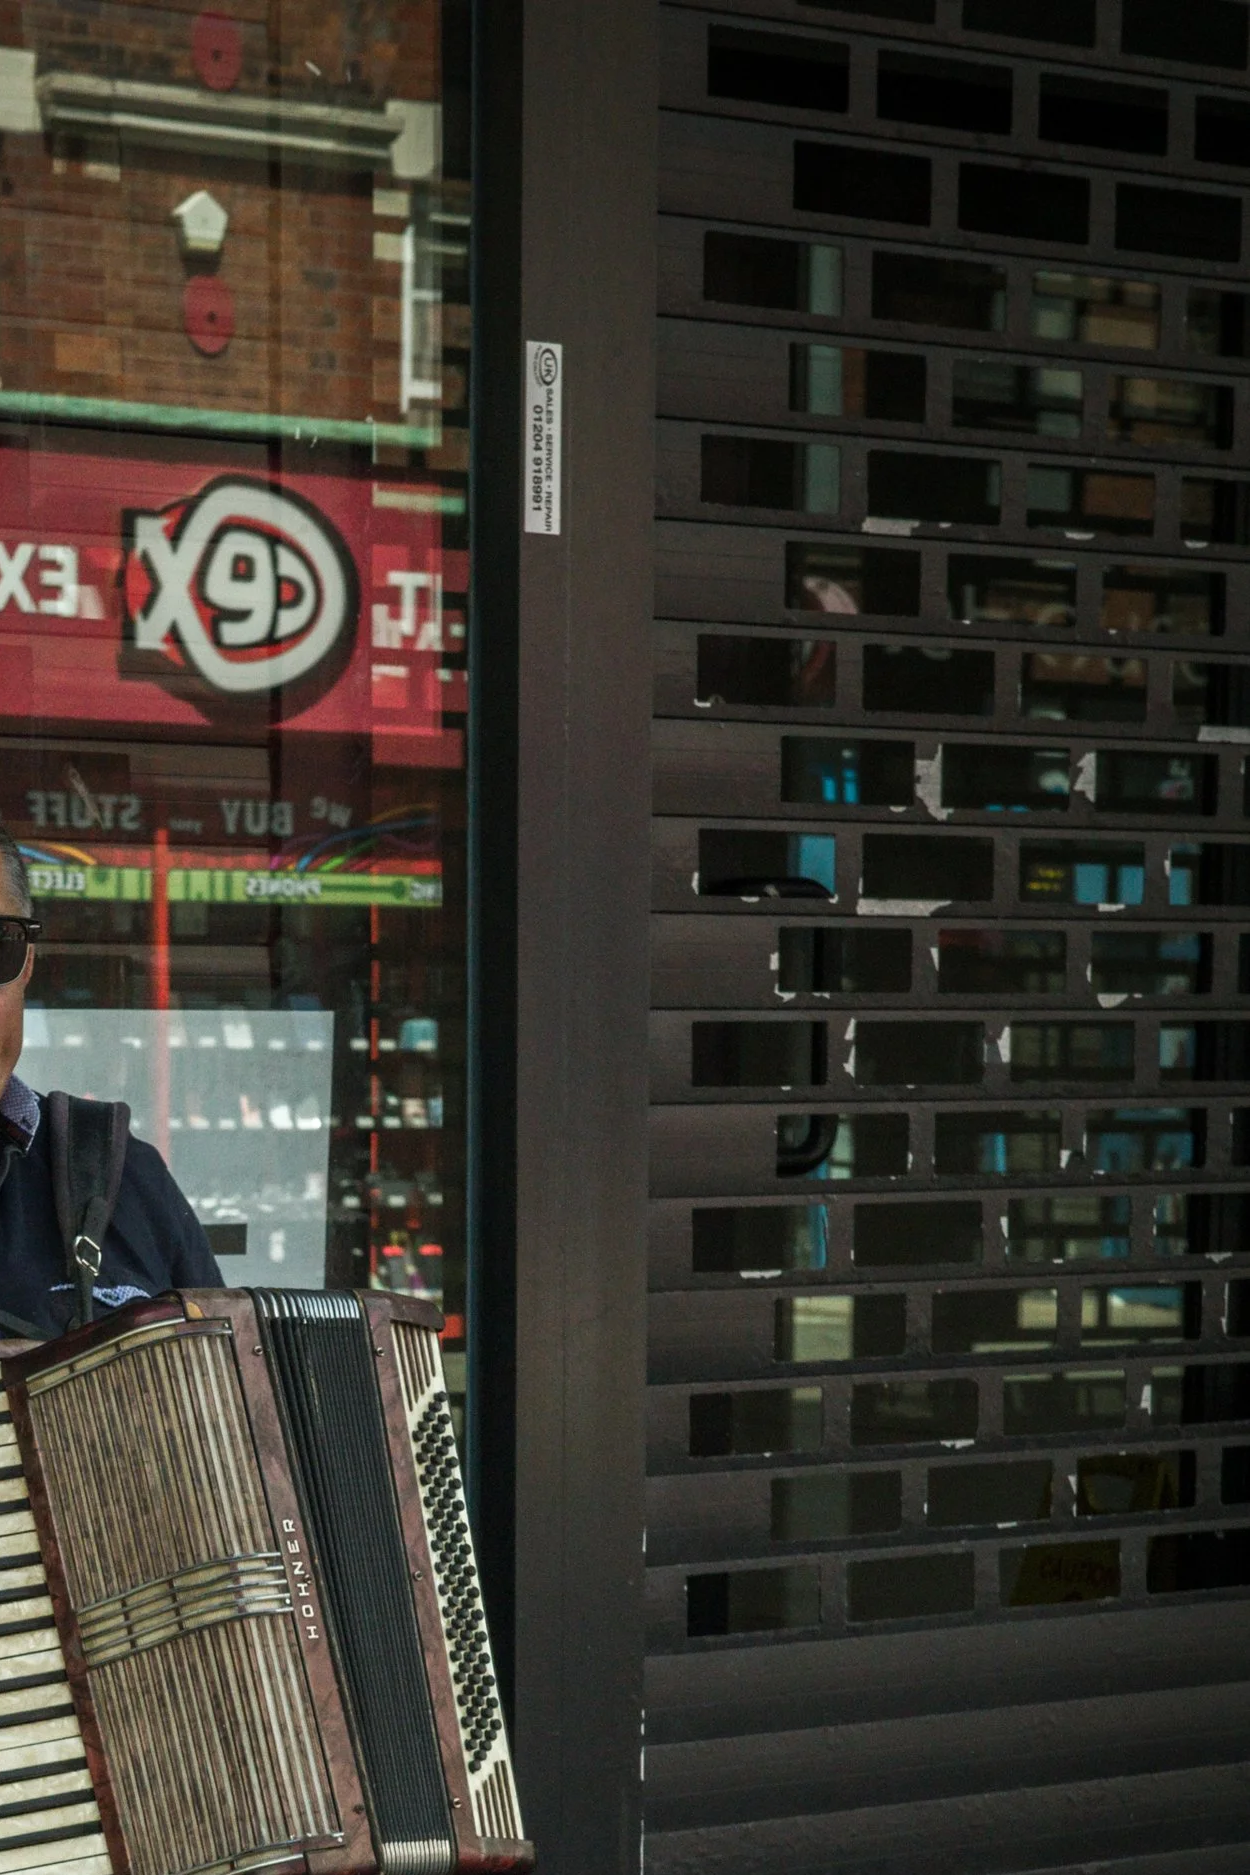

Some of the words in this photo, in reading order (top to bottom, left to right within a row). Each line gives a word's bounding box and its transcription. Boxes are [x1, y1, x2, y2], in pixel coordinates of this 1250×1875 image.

[533, 404, 543, 452] 01204
[545, 388, 554, 425] SALES
[545, 433, 554, 482] SERVICE
[544, 491, 553, 532] REPAIR
[282, 1519, 319, 1639] HOHNER
